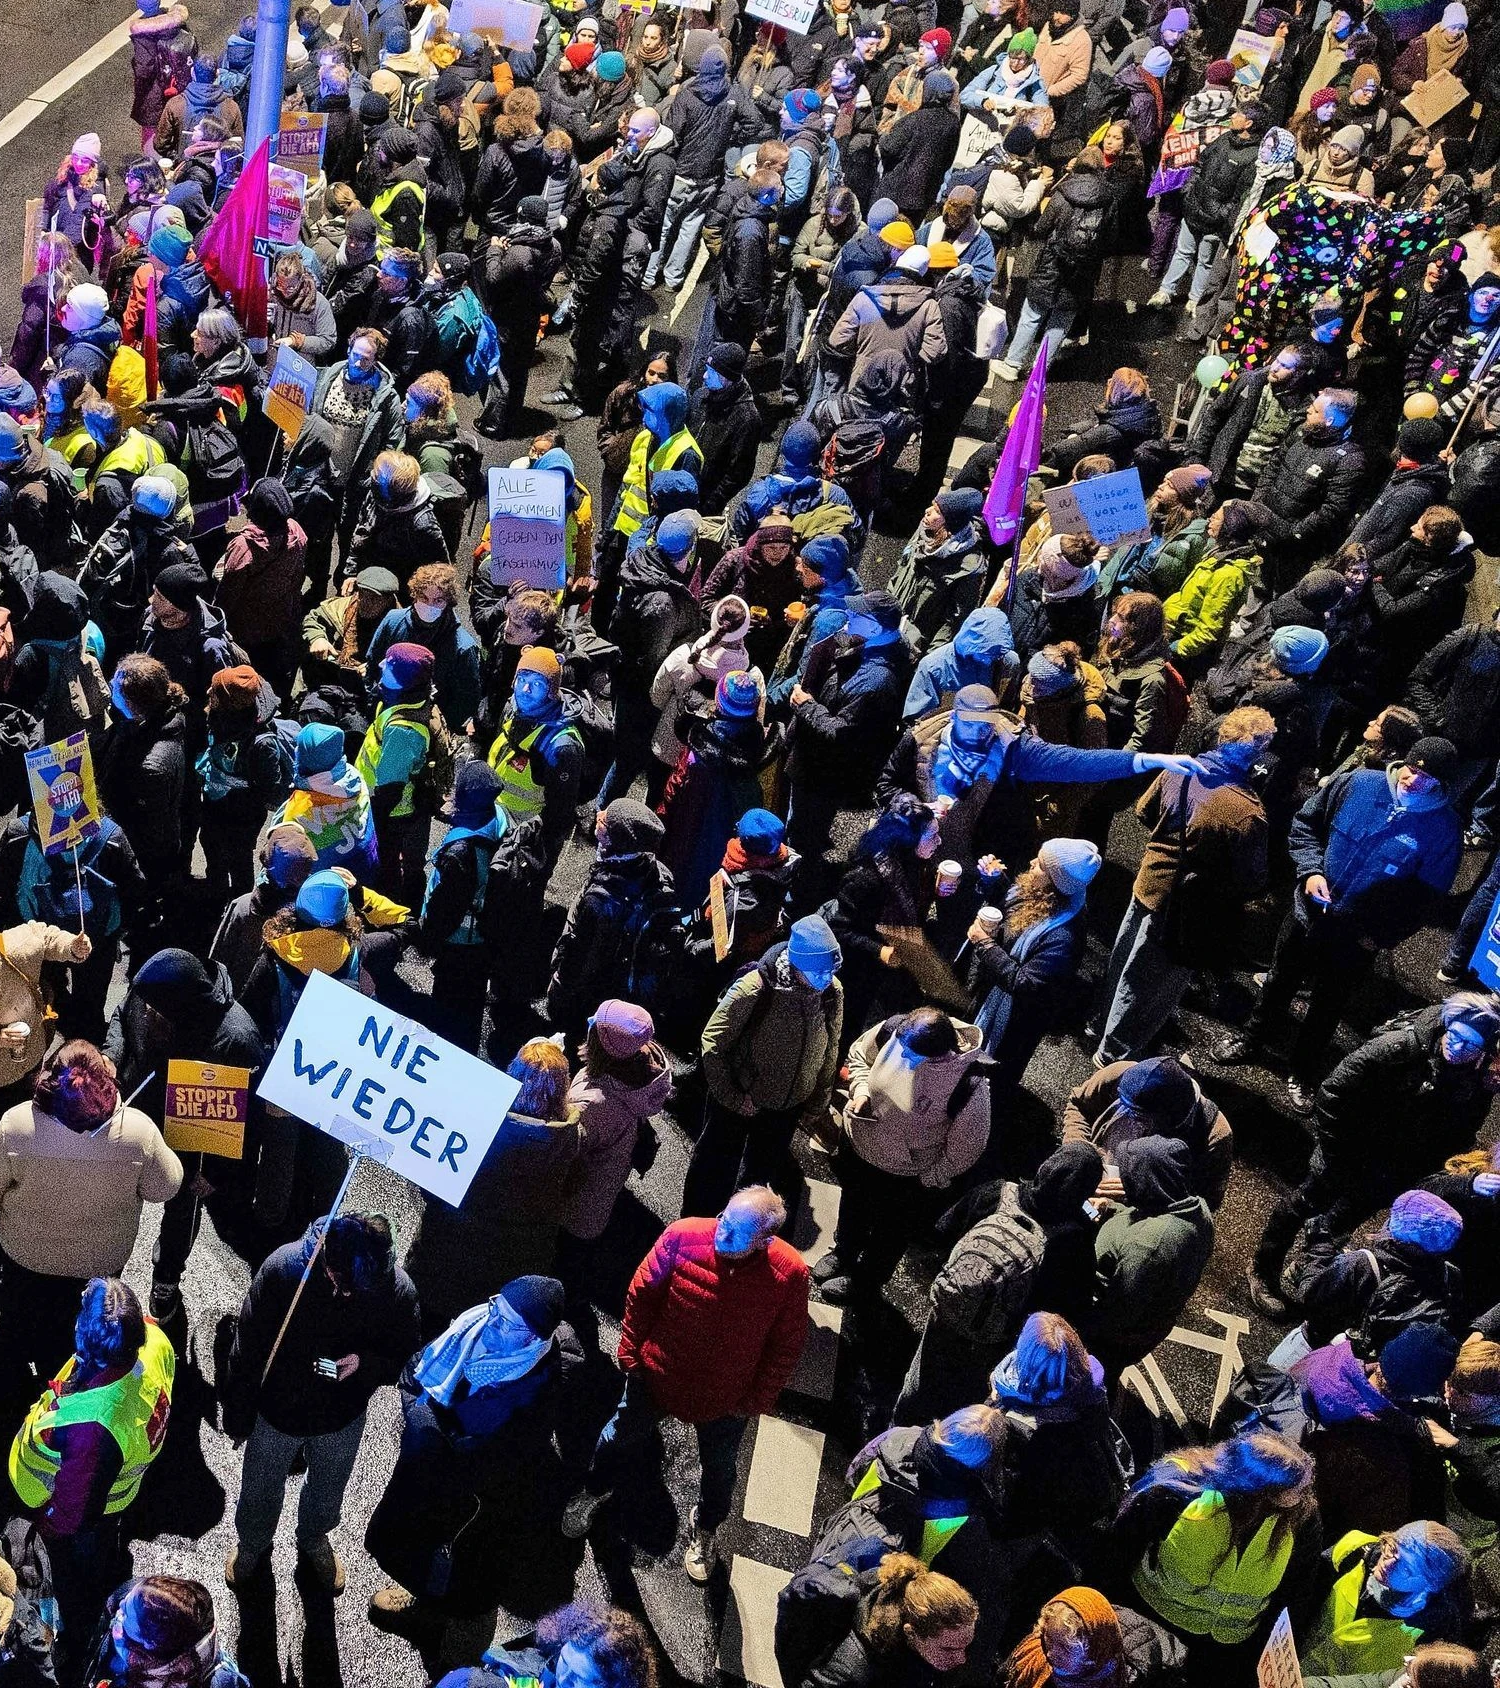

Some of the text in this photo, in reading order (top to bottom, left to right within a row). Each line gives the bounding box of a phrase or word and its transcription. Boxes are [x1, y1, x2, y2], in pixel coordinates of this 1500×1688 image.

[281, 131, 320, 143] STOPPT
[281, 141, 319, 155] DIE AFD
[277, 367, 309, 393] STOPPT
[274, 380, 306, 406] DIE AFD
[498, 477, 536, 496] ALLE
[494, 503, 561, 517] ZUSAMMEN
[1094, 506, 1119, 518] von
[499, 530, 564, 546] GEGEN DEN
[50, 776, 79, 798] STOPPT
[63, 788, 81, 811] AFD
[358, 1015, 440, 1084] NIE
[175, 1087, 237, 1105] STOPPT
[293, 1038, 469, 1173] WIEDER
[176, 1101, 238, 1120] DIE AFD
